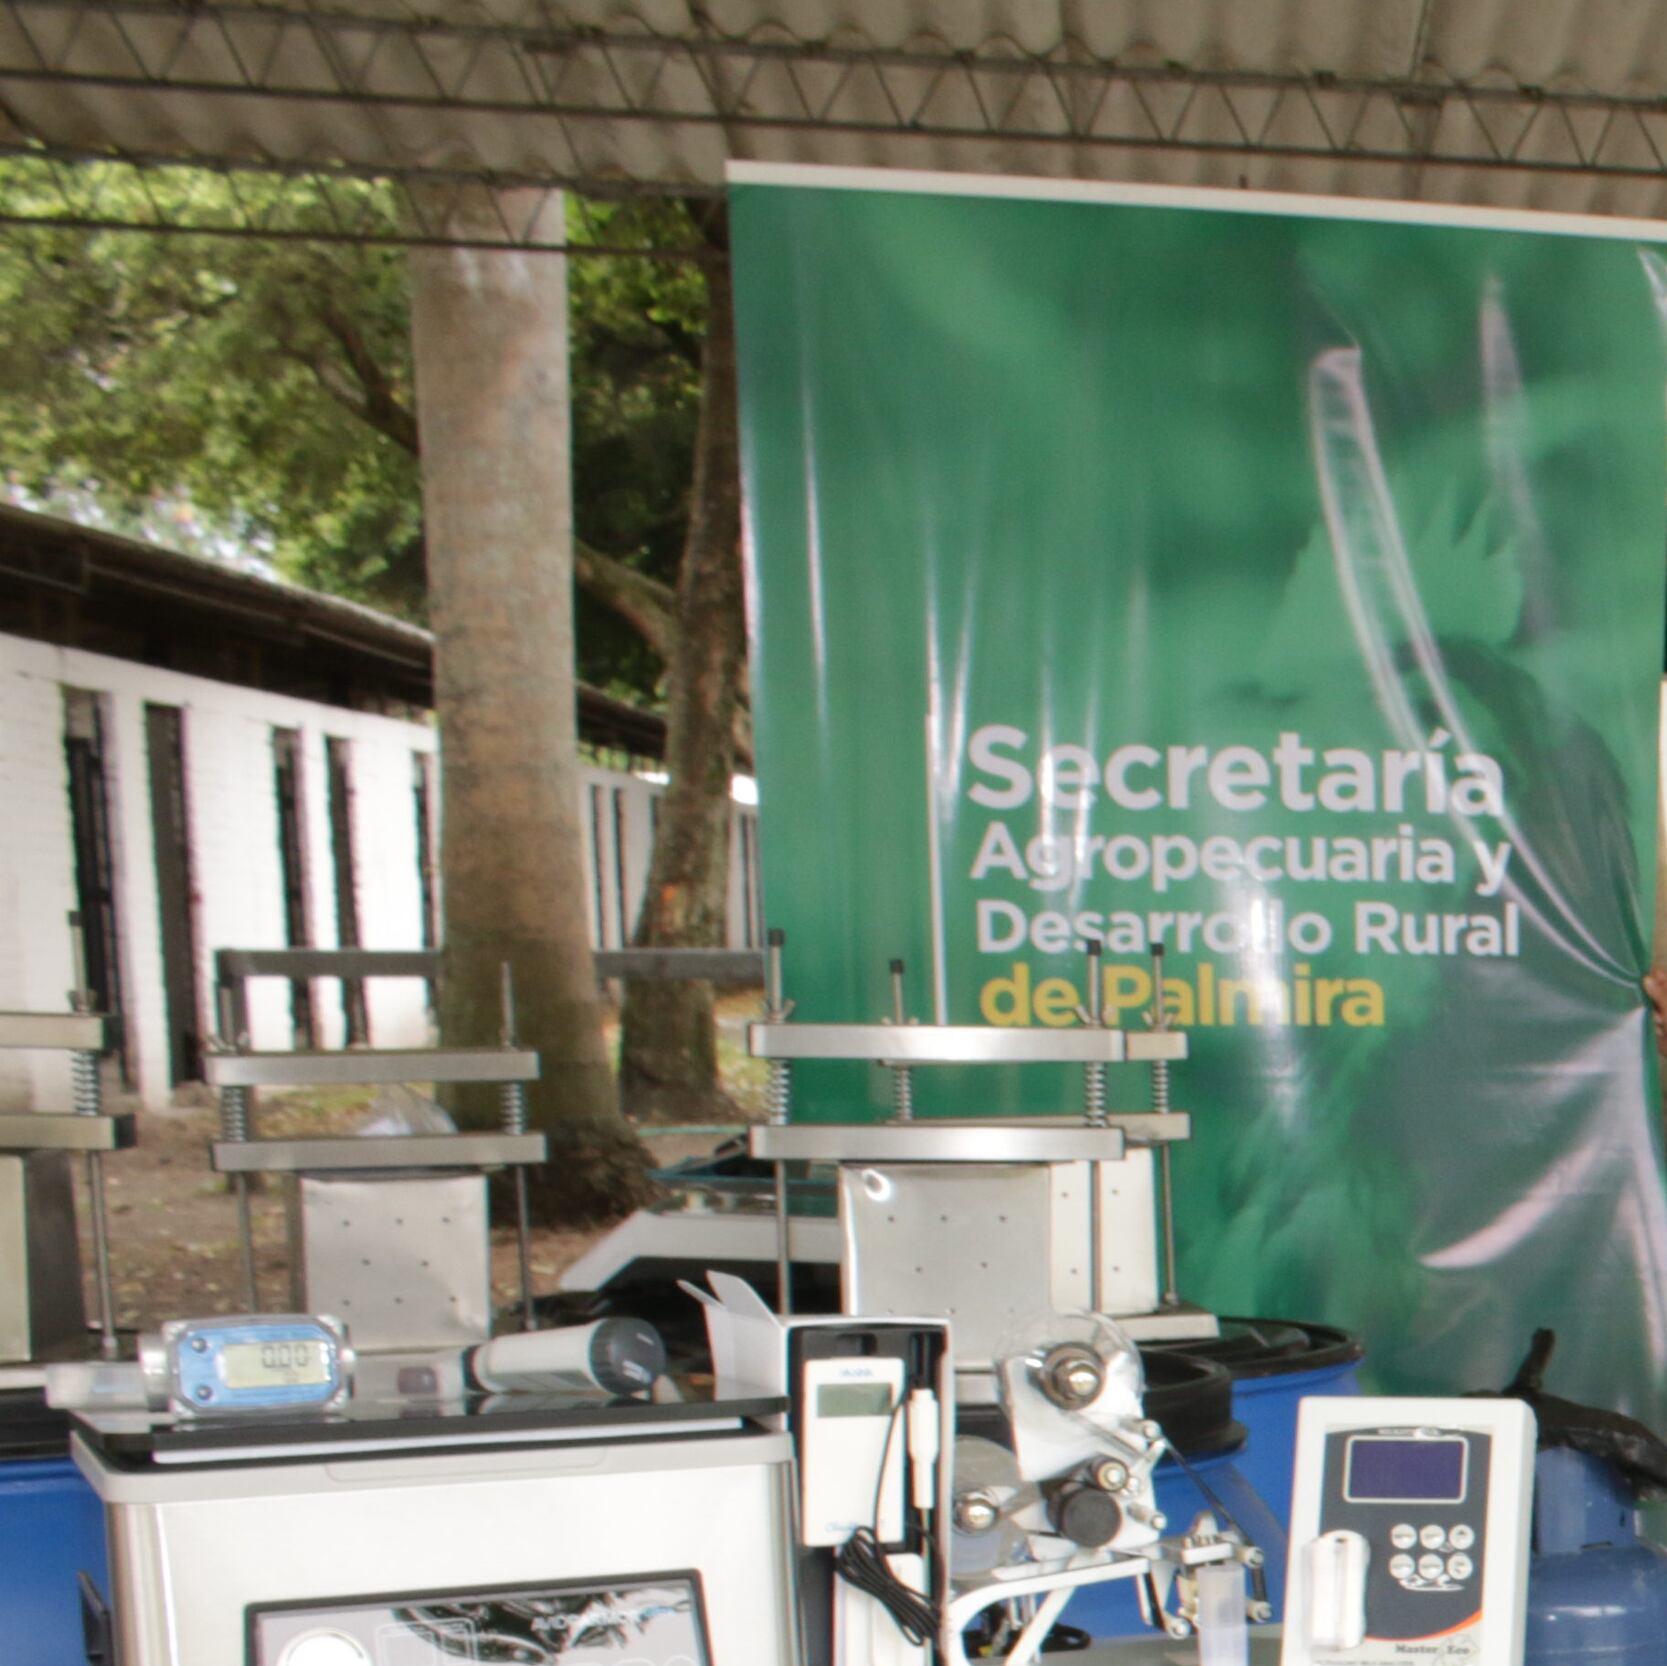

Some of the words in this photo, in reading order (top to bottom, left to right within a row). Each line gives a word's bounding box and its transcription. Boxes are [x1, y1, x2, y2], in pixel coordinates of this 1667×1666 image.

[967, 724, 1504, 818] Secretaría
[970, 821, 1456, 893] Agropecuaria
[1472, 838, 1512, 896] y
[976, 898, 1333, 954] Desarrollo
[1354, 901, 1519, 957] Rural
[980, 962, 1080, 1026] de
[1101, 962, 1386, 1027] Palmira
